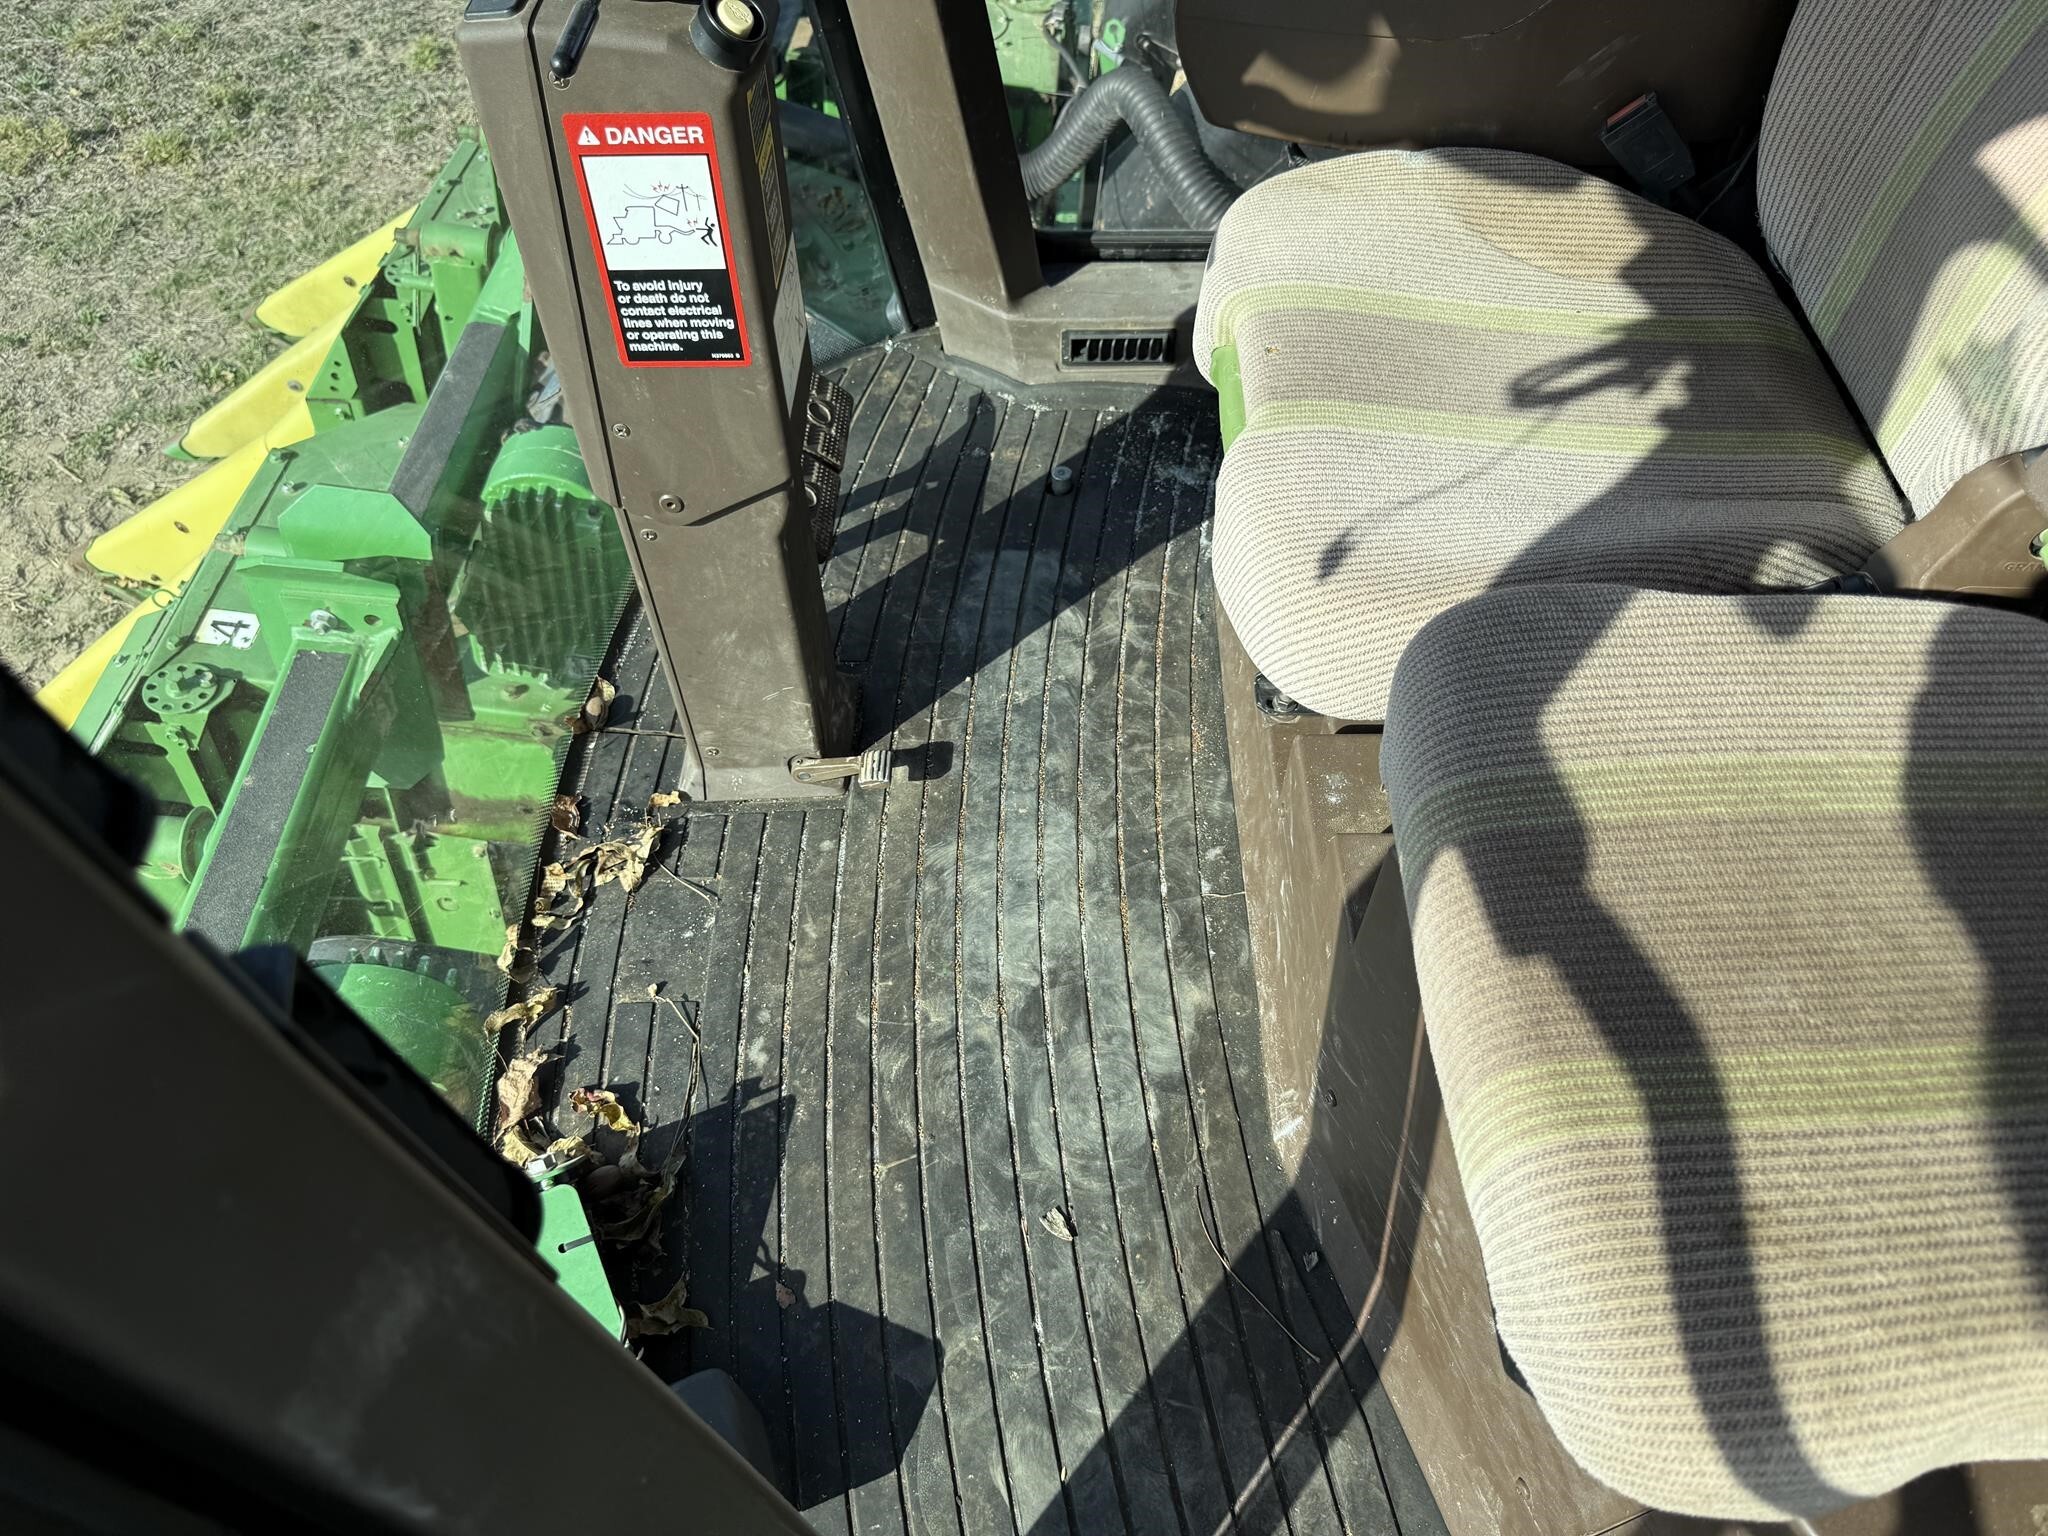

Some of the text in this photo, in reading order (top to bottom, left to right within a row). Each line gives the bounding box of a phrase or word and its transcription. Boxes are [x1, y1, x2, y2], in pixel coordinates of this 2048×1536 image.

[604, 126, 705, 145] DANGER
[613, 280, 703, 293] To avoid injury
[617, 293, 710, 304] or death do not
[620, 305, 723, 316] contact electrical
[622, 317, 735, 329] lines when moving
[626, 329, 724, 342] or operating this
[629, 341, 684, 352] machine.
[210, 620, 251, 639] 4
